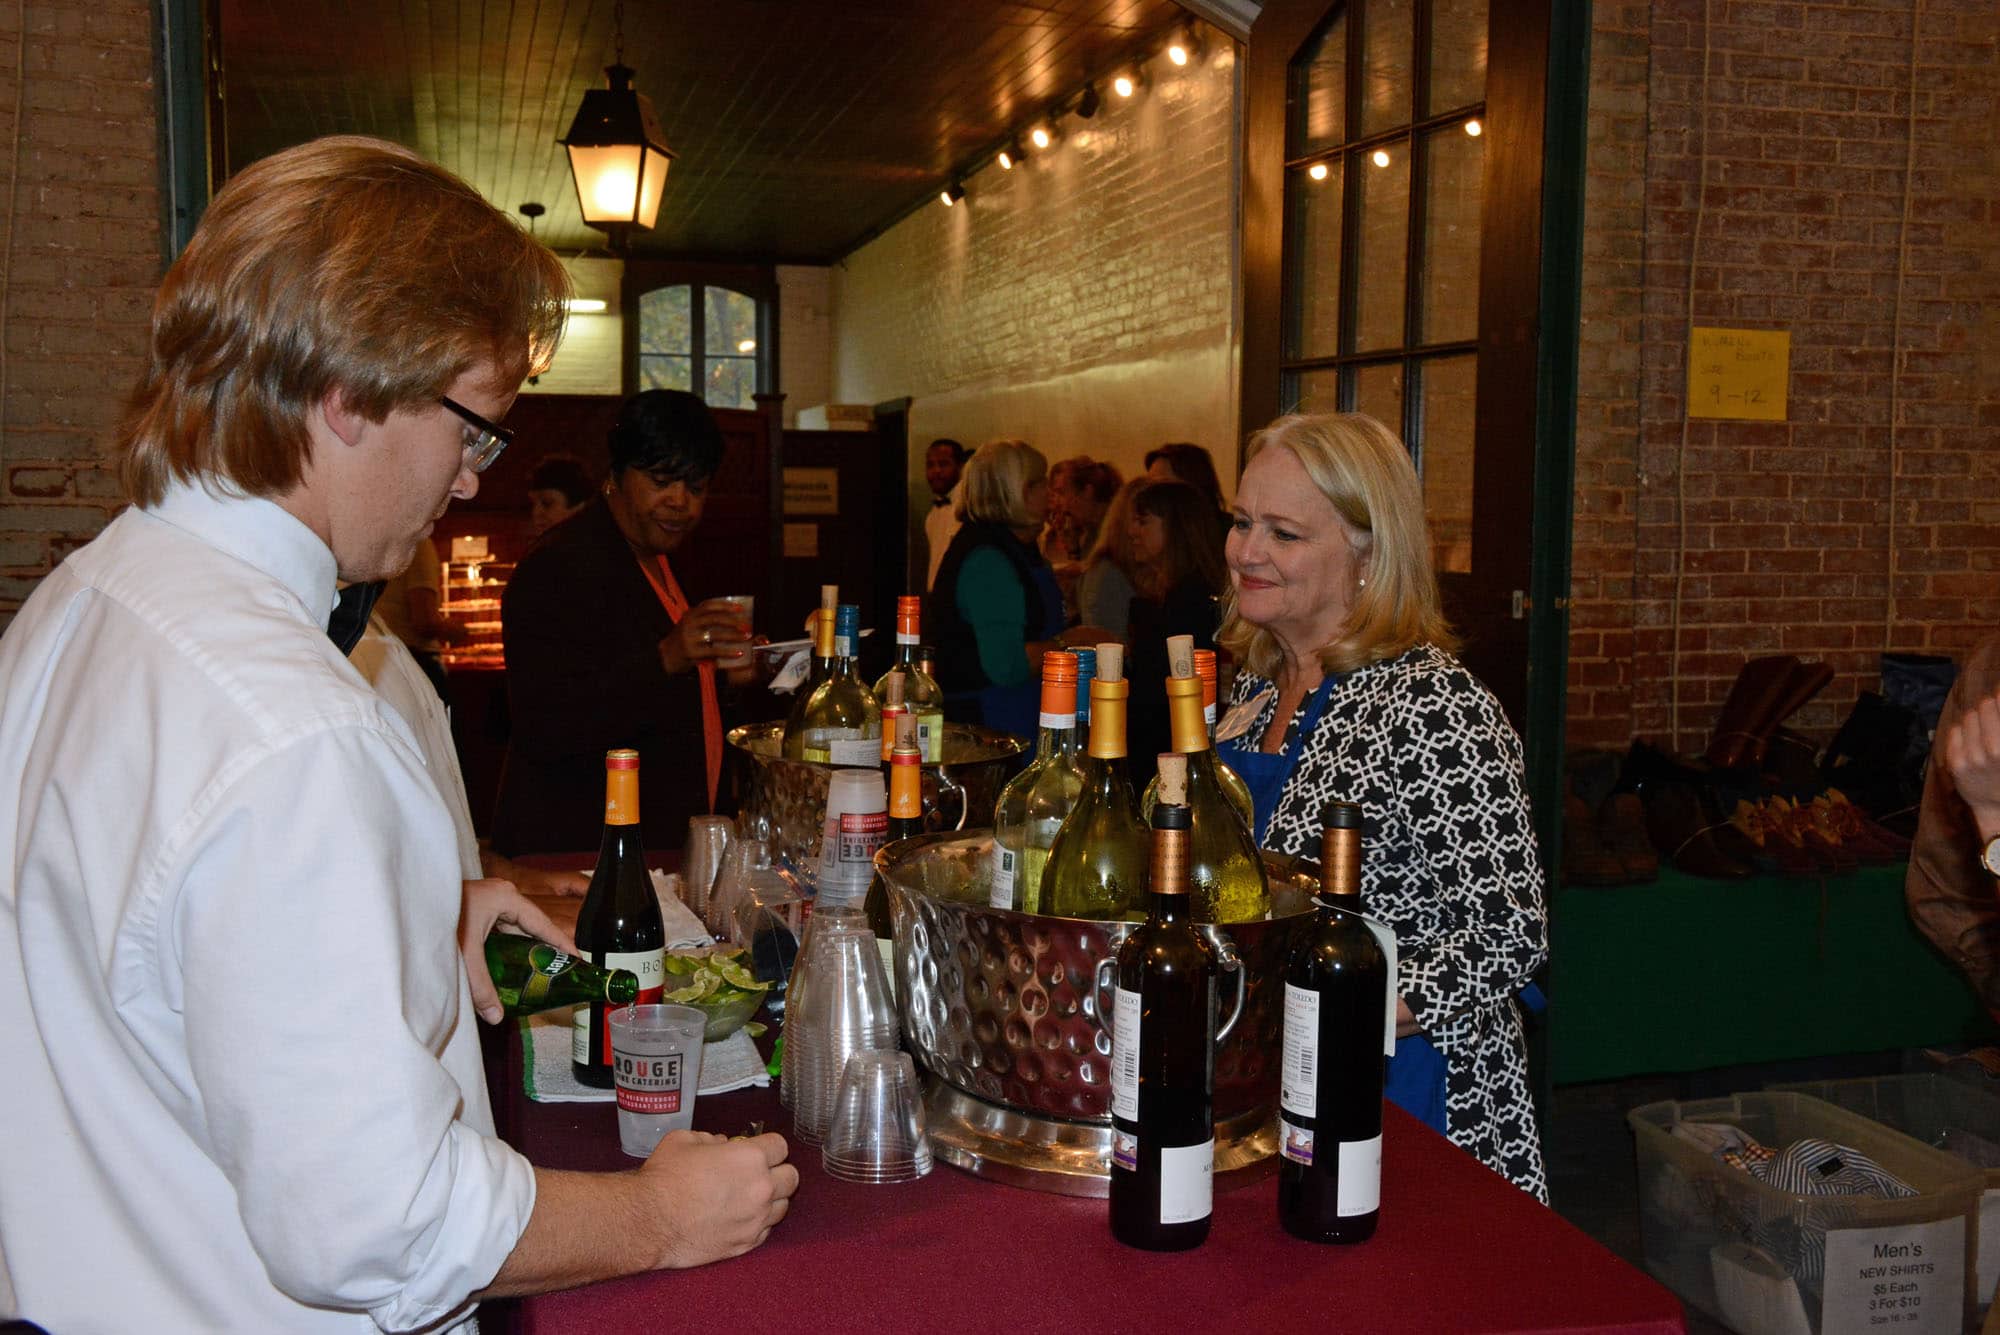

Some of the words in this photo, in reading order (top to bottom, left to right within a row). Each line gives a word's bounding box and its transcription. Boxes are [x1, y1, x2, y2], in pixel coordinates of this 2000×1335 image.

[615, 1056, 677, 1078] ROUGE
[632, 1076, 677, 1087] CATERING
[1873, 1242, 1923, 1259] Men's
[1859, 1267, 1886, 1280] NEW
[1890, 1263, 1935, 1277] SHIRTS
[1873, 1283, 1887, 1297] $5
[1890, 1282, 1918, 1294] Each
[1869, 1300, 1877, 1311] 3
[1879, 1299, 1896, 1310] For
[1899, 1296, 1921, 1309] $10
